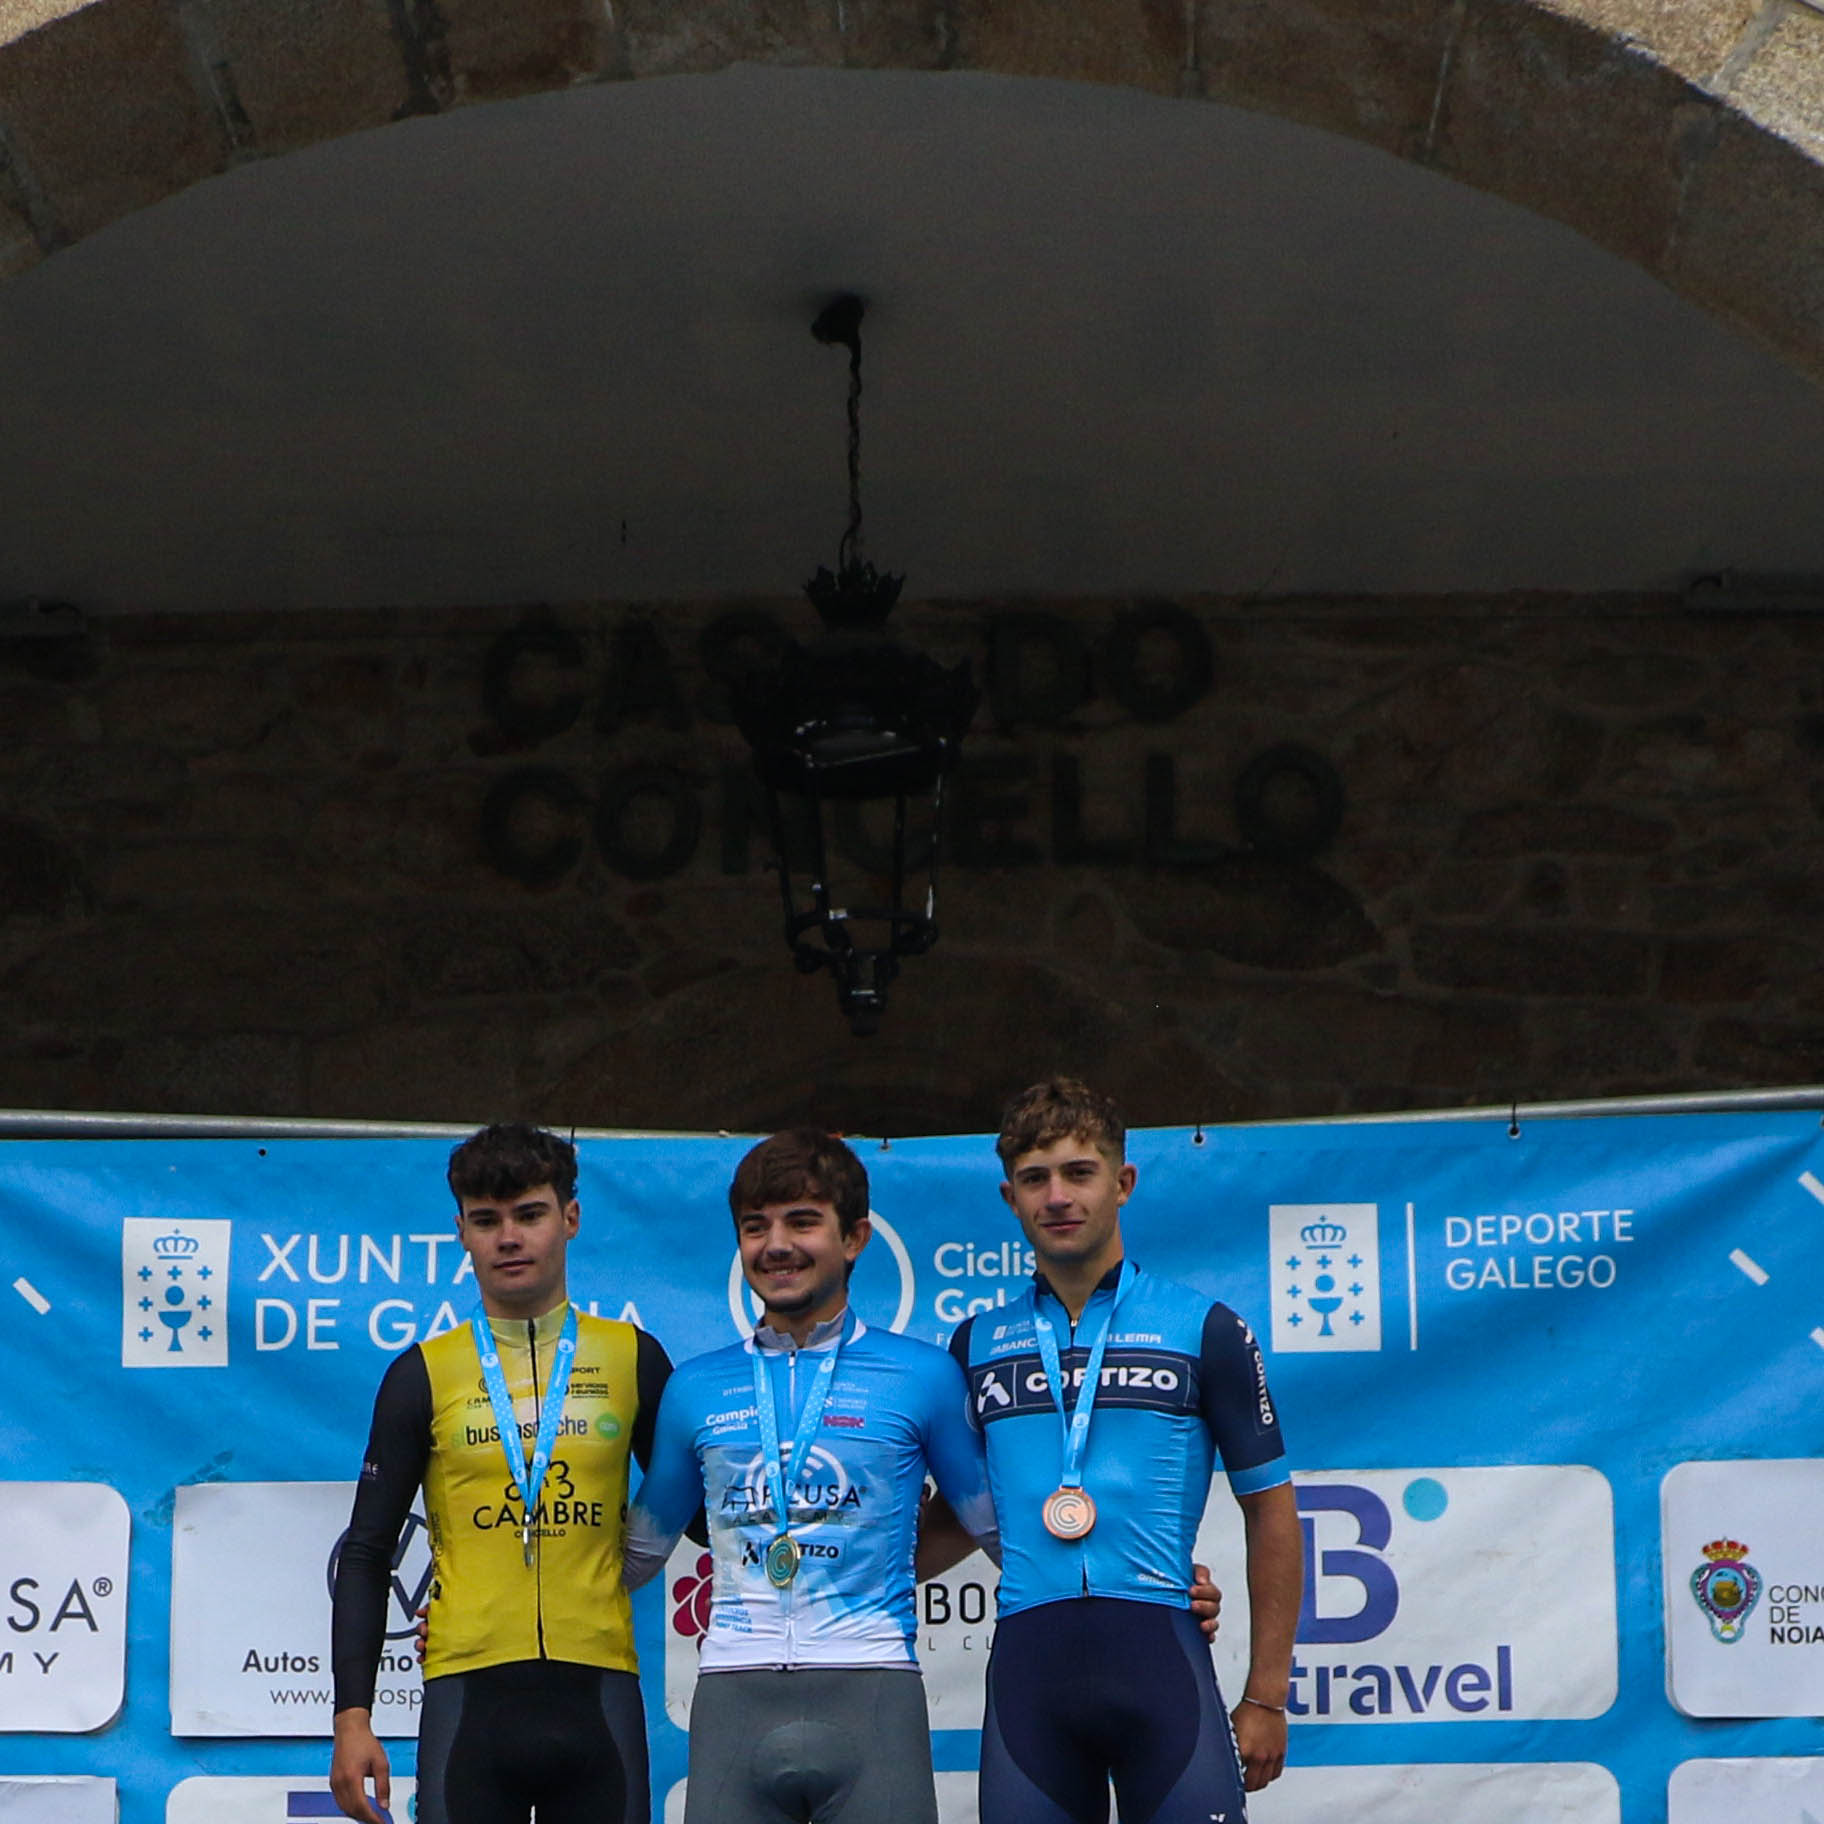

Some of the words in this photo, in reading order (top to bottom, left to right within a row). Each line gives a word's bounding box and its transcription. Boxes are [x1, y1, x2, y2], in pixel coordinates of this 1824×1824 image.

[1446, 1210, 1634, 1247] DEPORTE
[934, 1241, 1037, 1278] Ciclis
[1446, 1255, 1617, 1291] GALEGO
[256, 1299, 338, 1351] DE
[1770, 1607, 1800, 1623] DE
[242, 1649, 319, 1673] Autos
